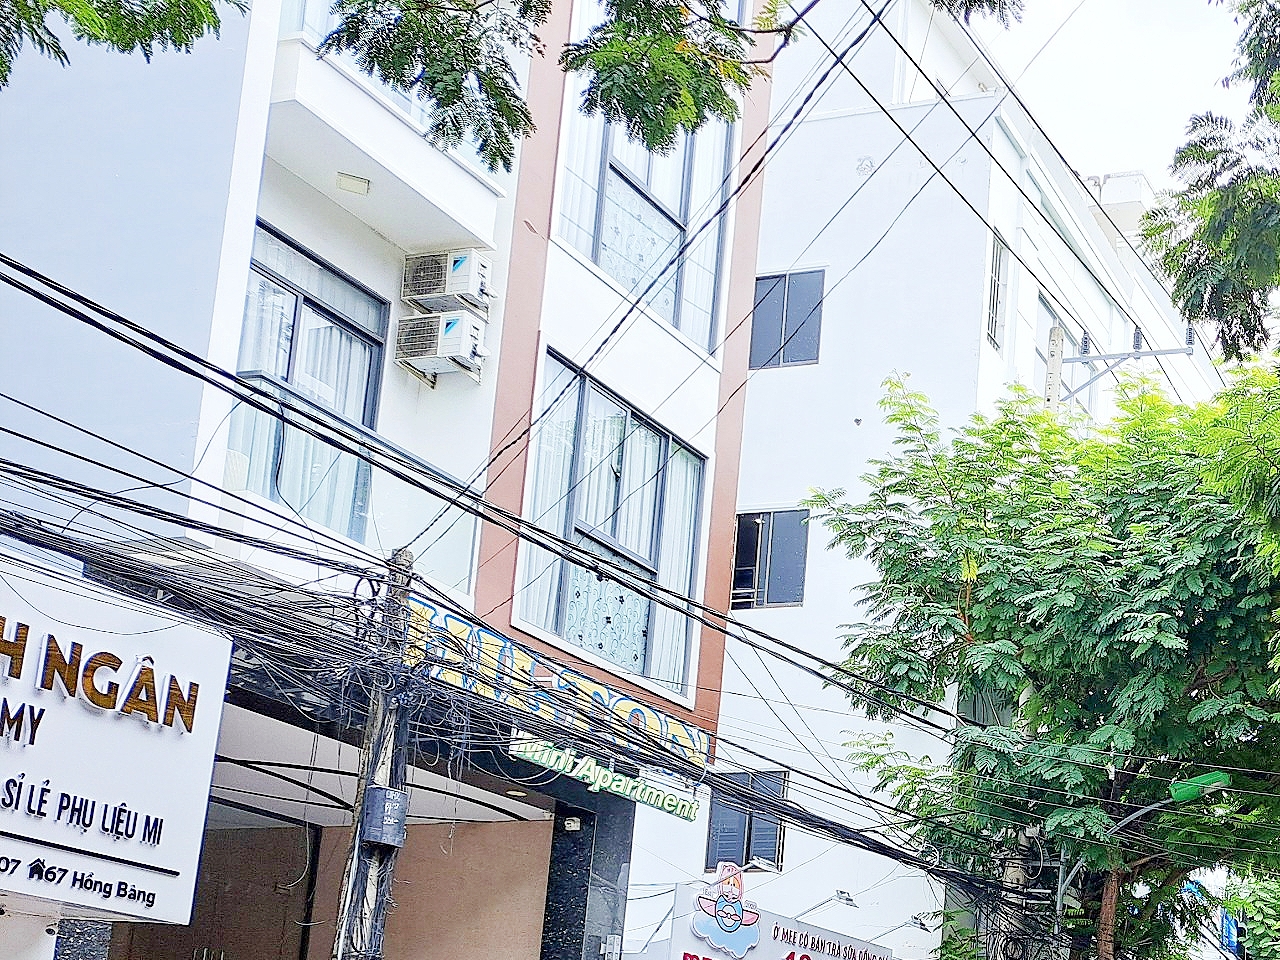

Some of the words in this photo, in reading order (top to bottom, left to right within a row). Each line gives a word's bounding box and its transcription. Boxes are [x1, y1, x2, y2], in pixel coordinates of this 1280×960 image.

[37, 633, 200, 734] NGÂN
[573, 755, 701, 823] Apartment
[55, 792, 96, 834] PHỤ
[100, 802, 139, 841] LIỆU
[141, 814, 165, 846] MI
[44, 865, 69, 885] 67
[71, 870, 113, 899] Hồng
[781, 927, 798, 946] MEE
[799, 931, 810, 950] CÓ
[810, 935, 827, 954] BÁN
[826, 940, 842, 958] TRÀ
